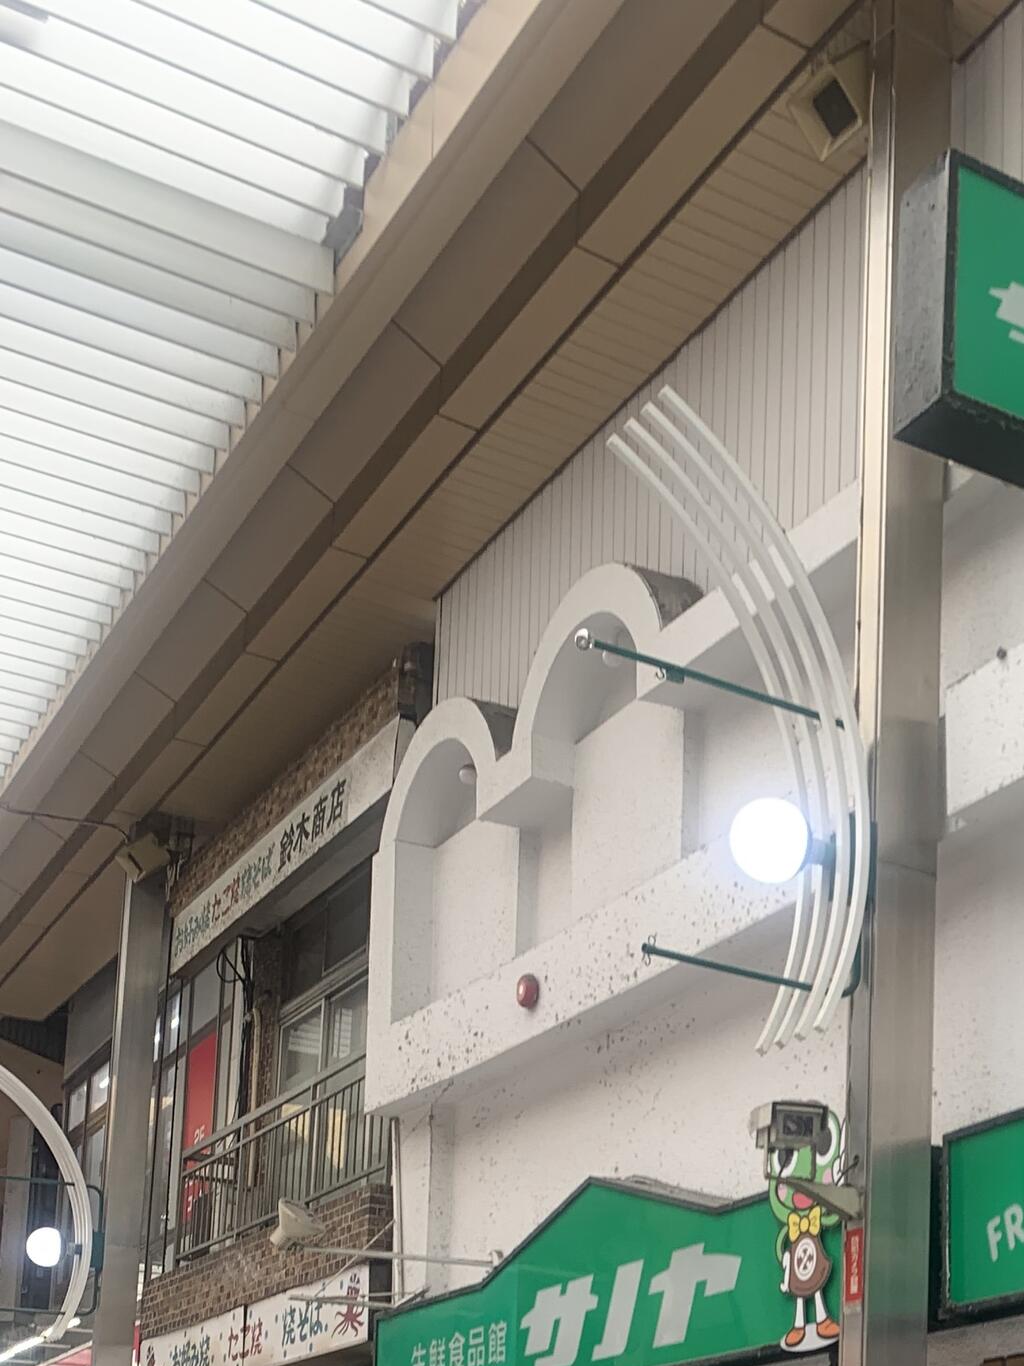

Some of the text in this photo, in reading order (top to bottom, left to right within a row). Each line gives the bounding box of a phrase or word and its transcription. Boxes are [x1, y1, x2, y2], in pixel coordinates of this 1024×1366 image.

[277, 778, 346, 873] 鈴木商店
[228, 1318, 263, 1361] たこ焼
[281, 1301, 324, 1347] 焼そば
